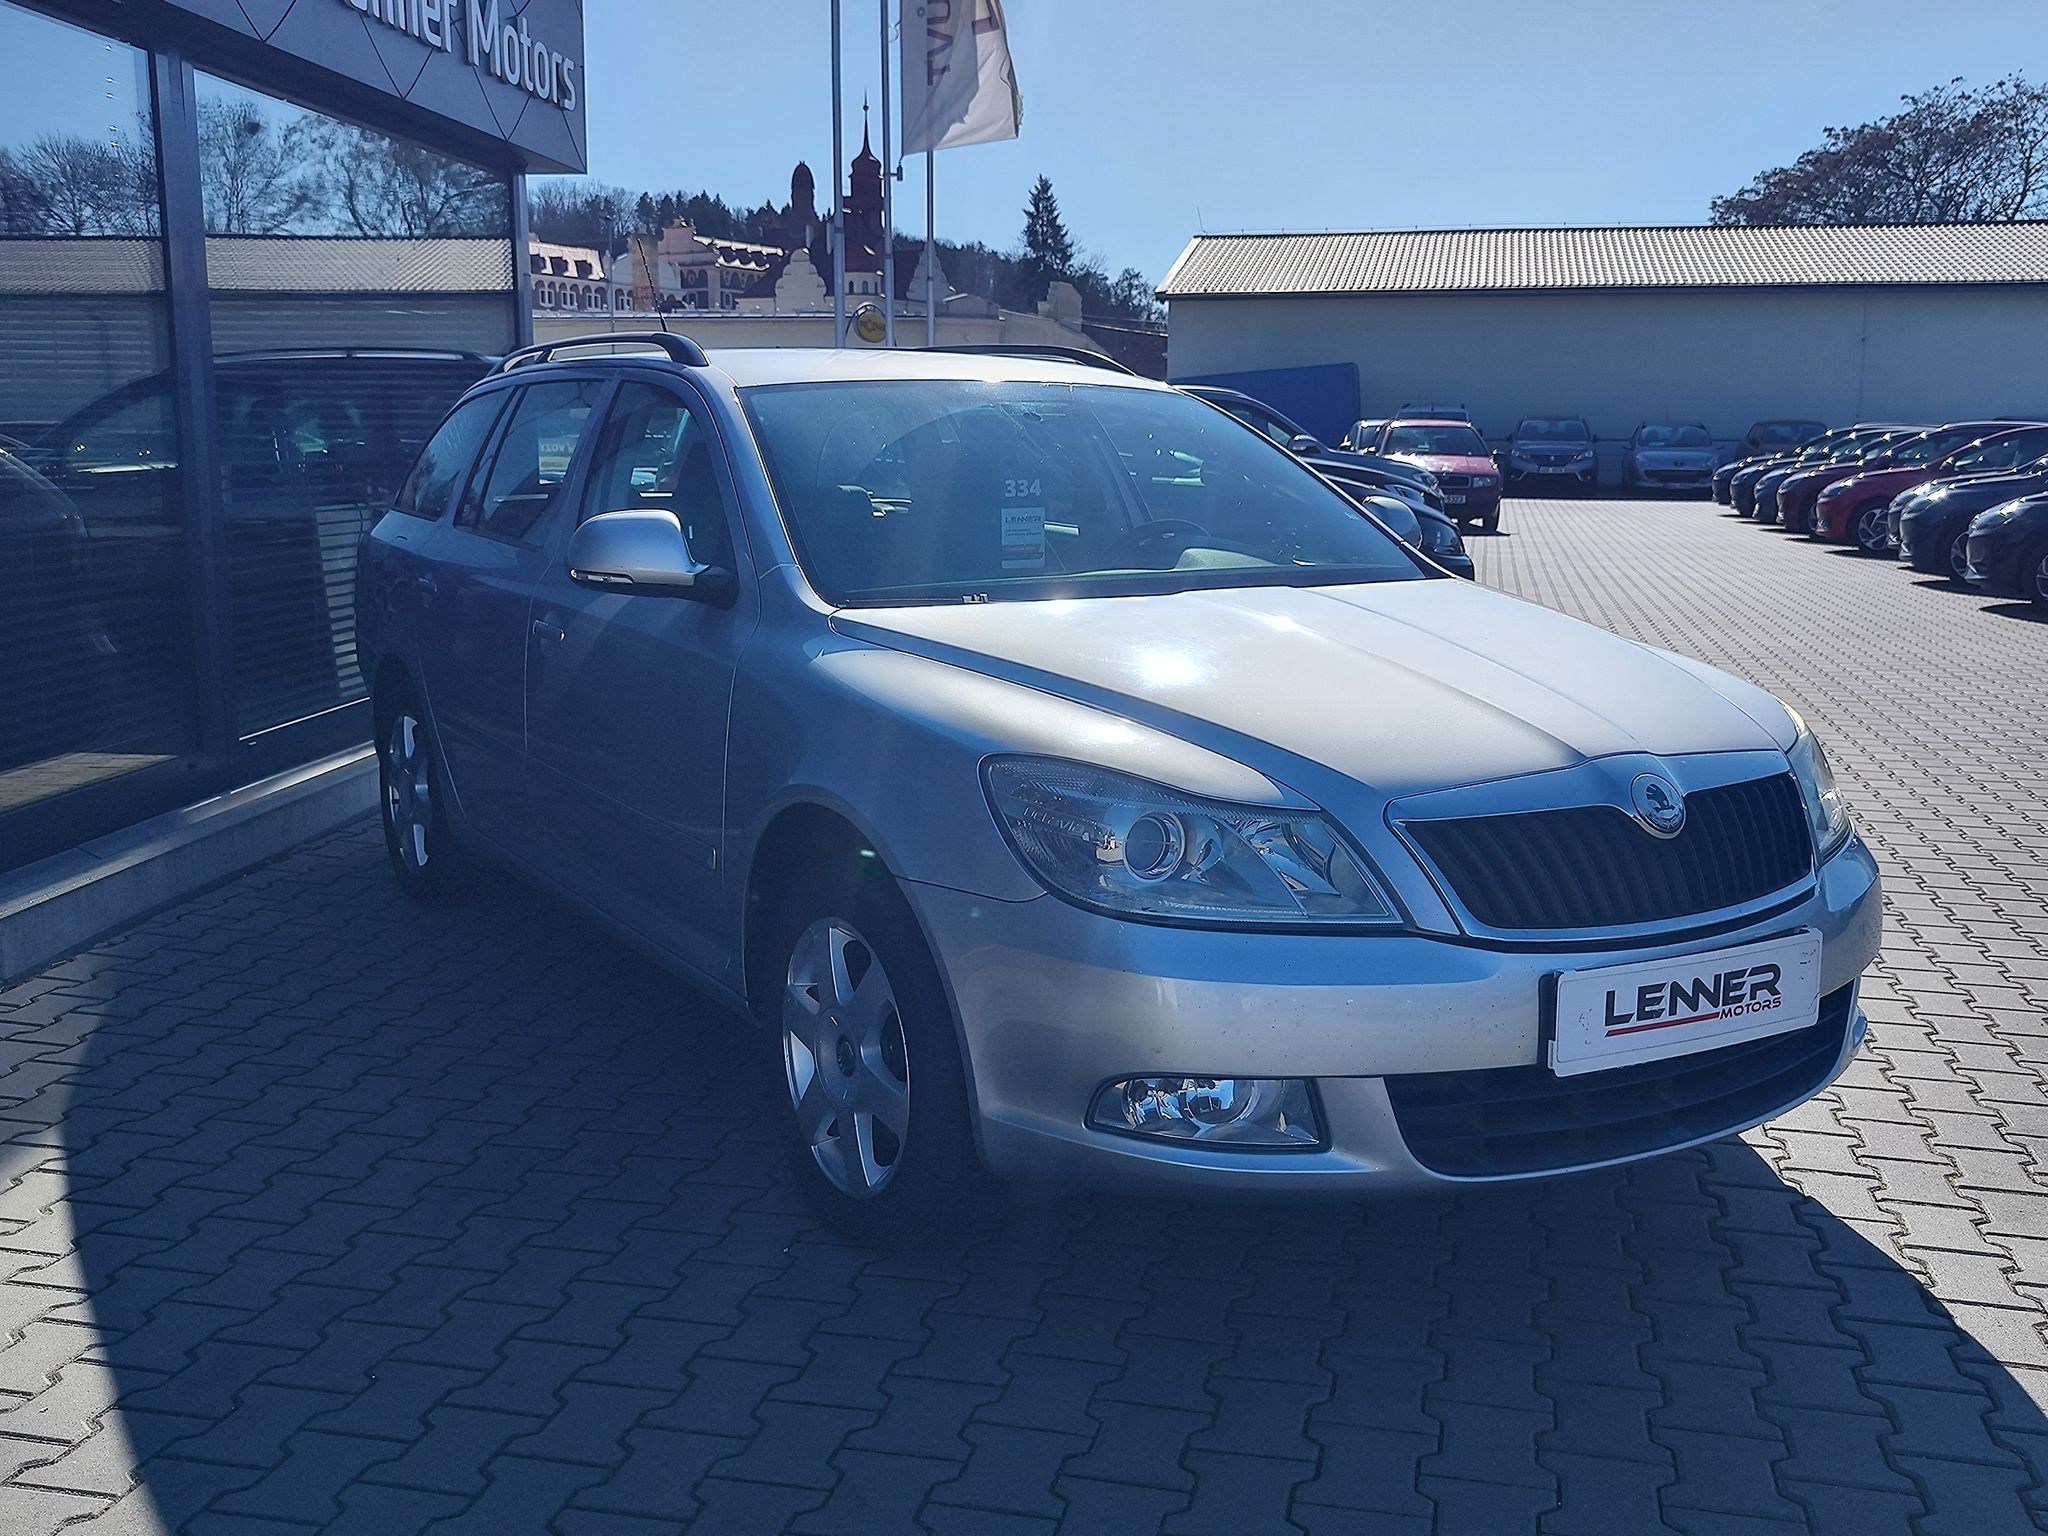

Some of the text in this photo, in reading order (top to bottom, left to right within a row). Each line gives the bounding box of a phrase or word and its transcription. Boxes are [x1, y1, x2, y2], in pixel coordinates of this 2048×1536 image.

[464, 0, 577, 111] Motors
[1004, 479, 1042, 498] 334
[1604, 962, 1782, 1027] LENNER
[1719, 996, 1782, 1021] MOTORS
